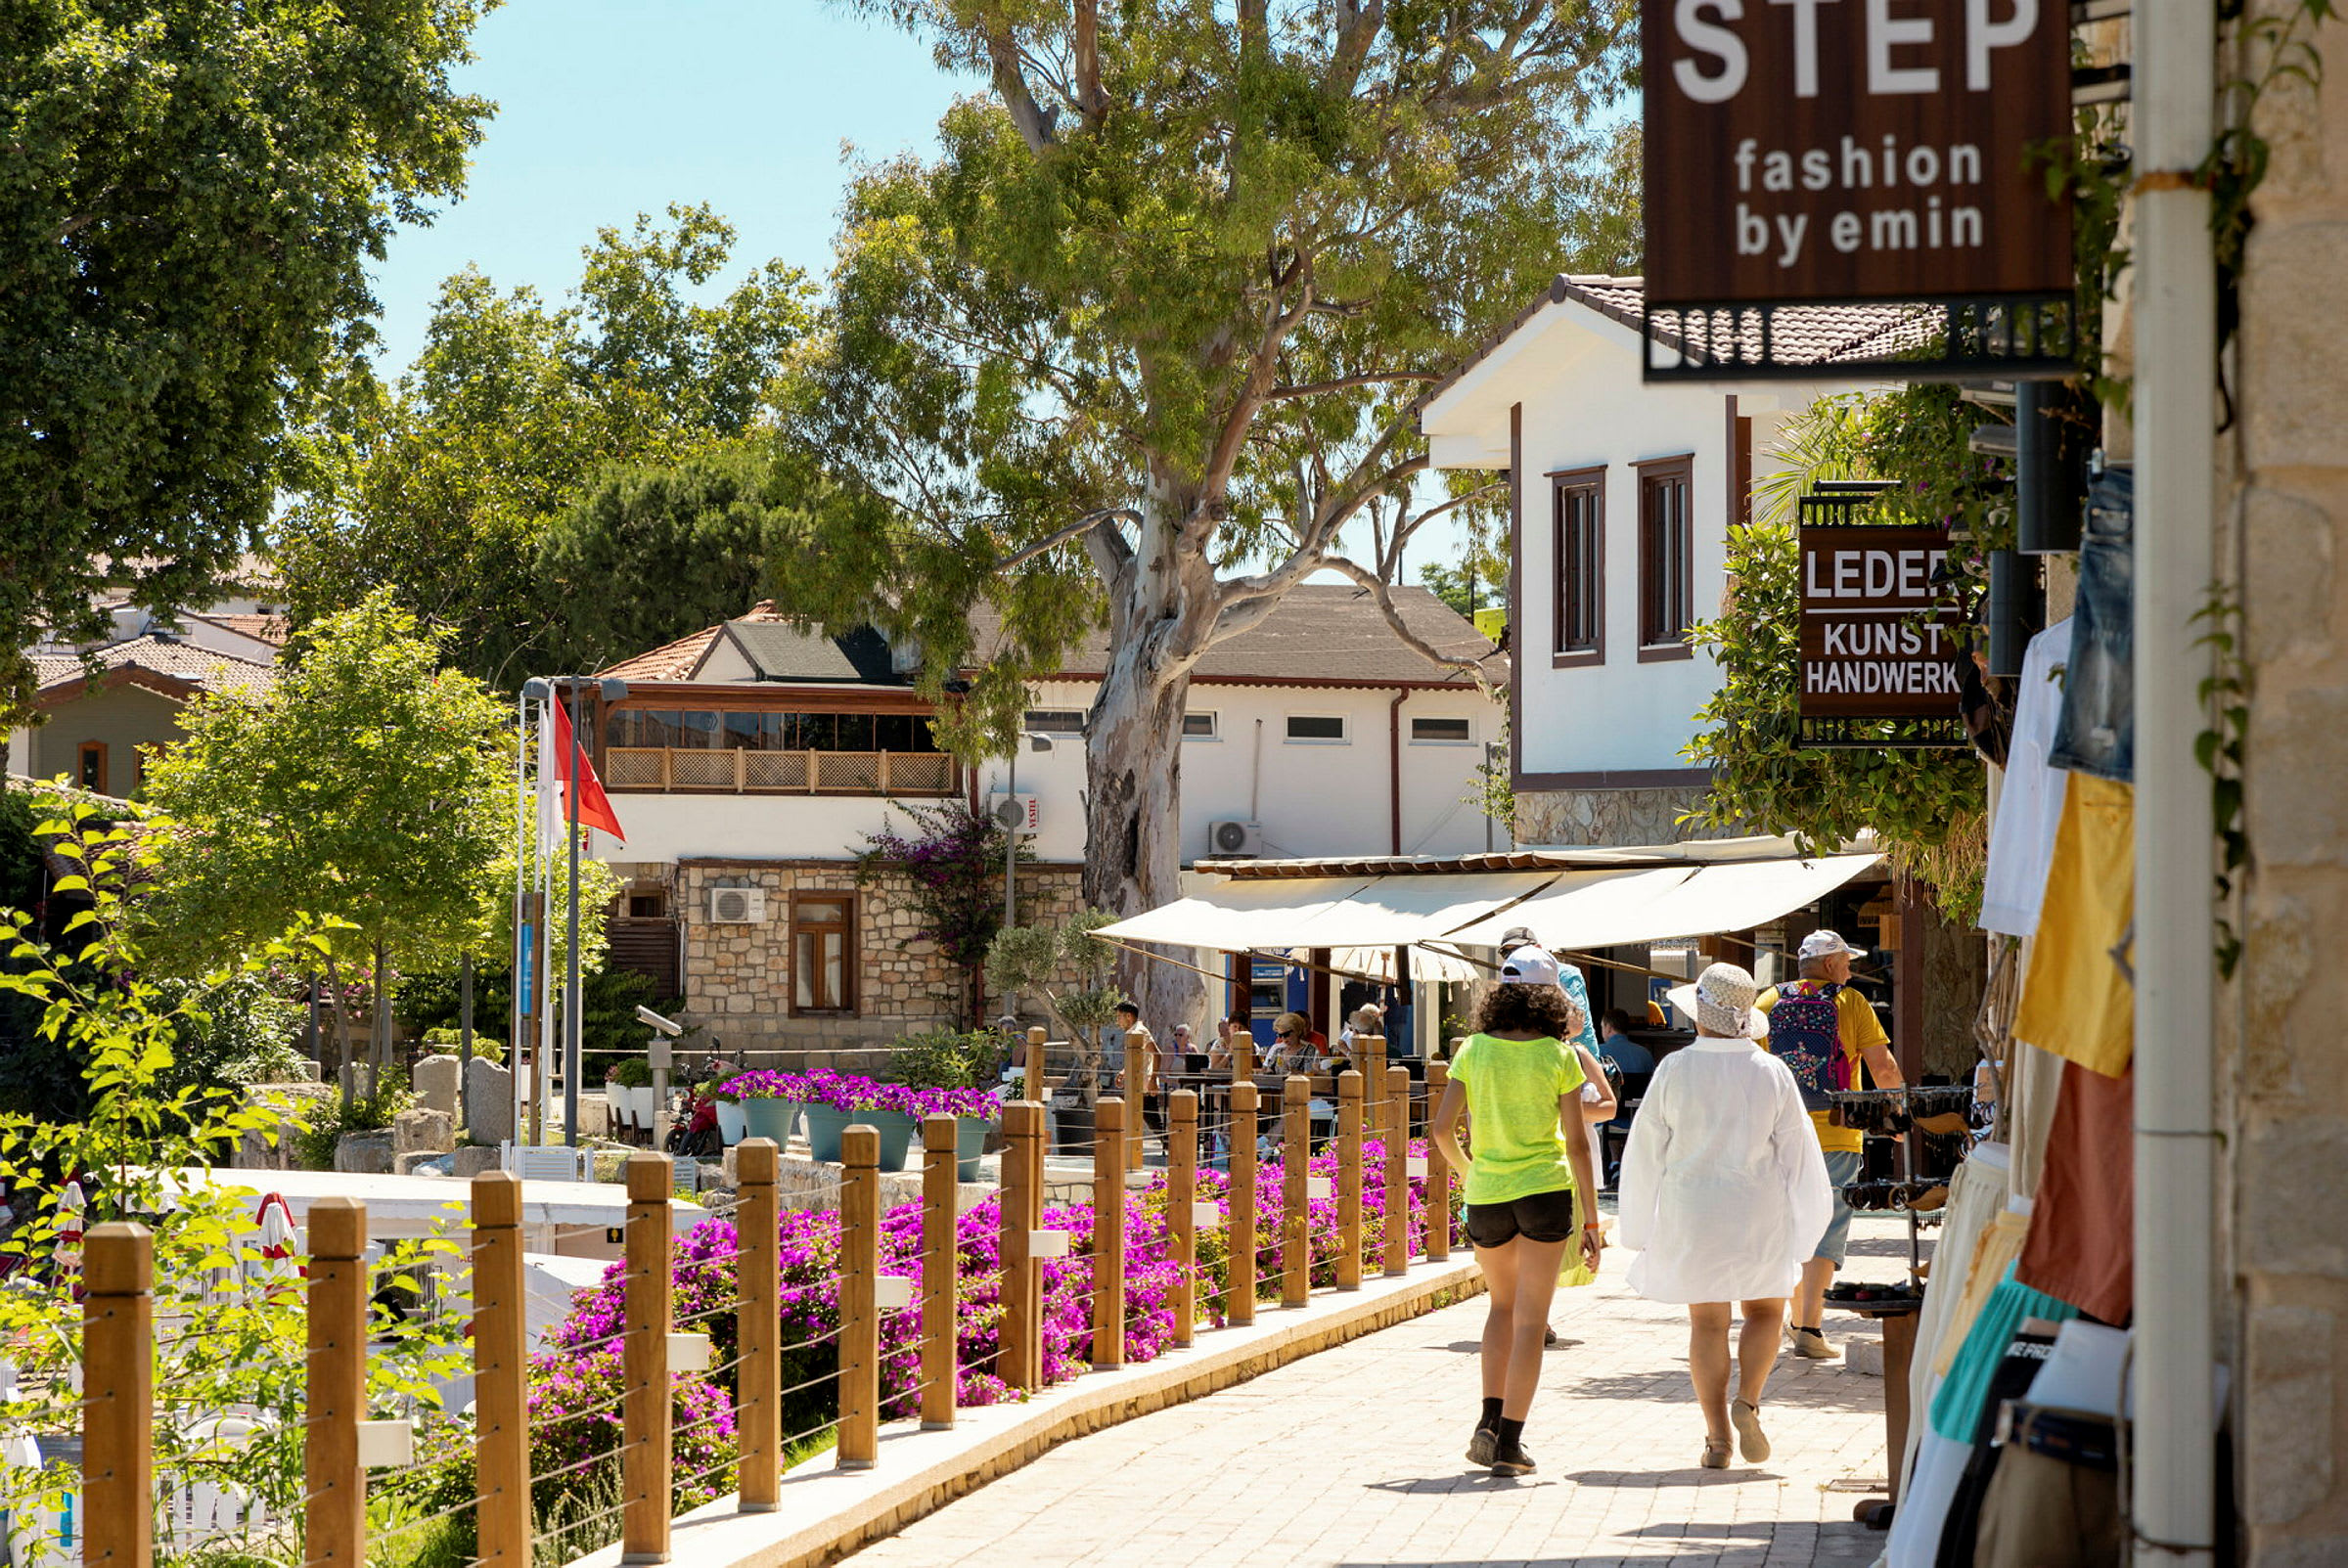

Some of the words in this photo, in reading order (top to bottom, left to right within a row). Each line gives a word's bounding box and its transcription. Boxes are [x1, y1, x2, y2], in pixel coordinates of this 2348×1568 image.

[1672, 0, 2040, 104] STEP
[1735, 133, 1981, 193] fashion
[1736, 202, 1808, 268] by
[1830, 195, 1983, 252] emin
[1825, 623, 1945, 655] KUNST
[1807, 661, 1962, 694] HANDWERK
